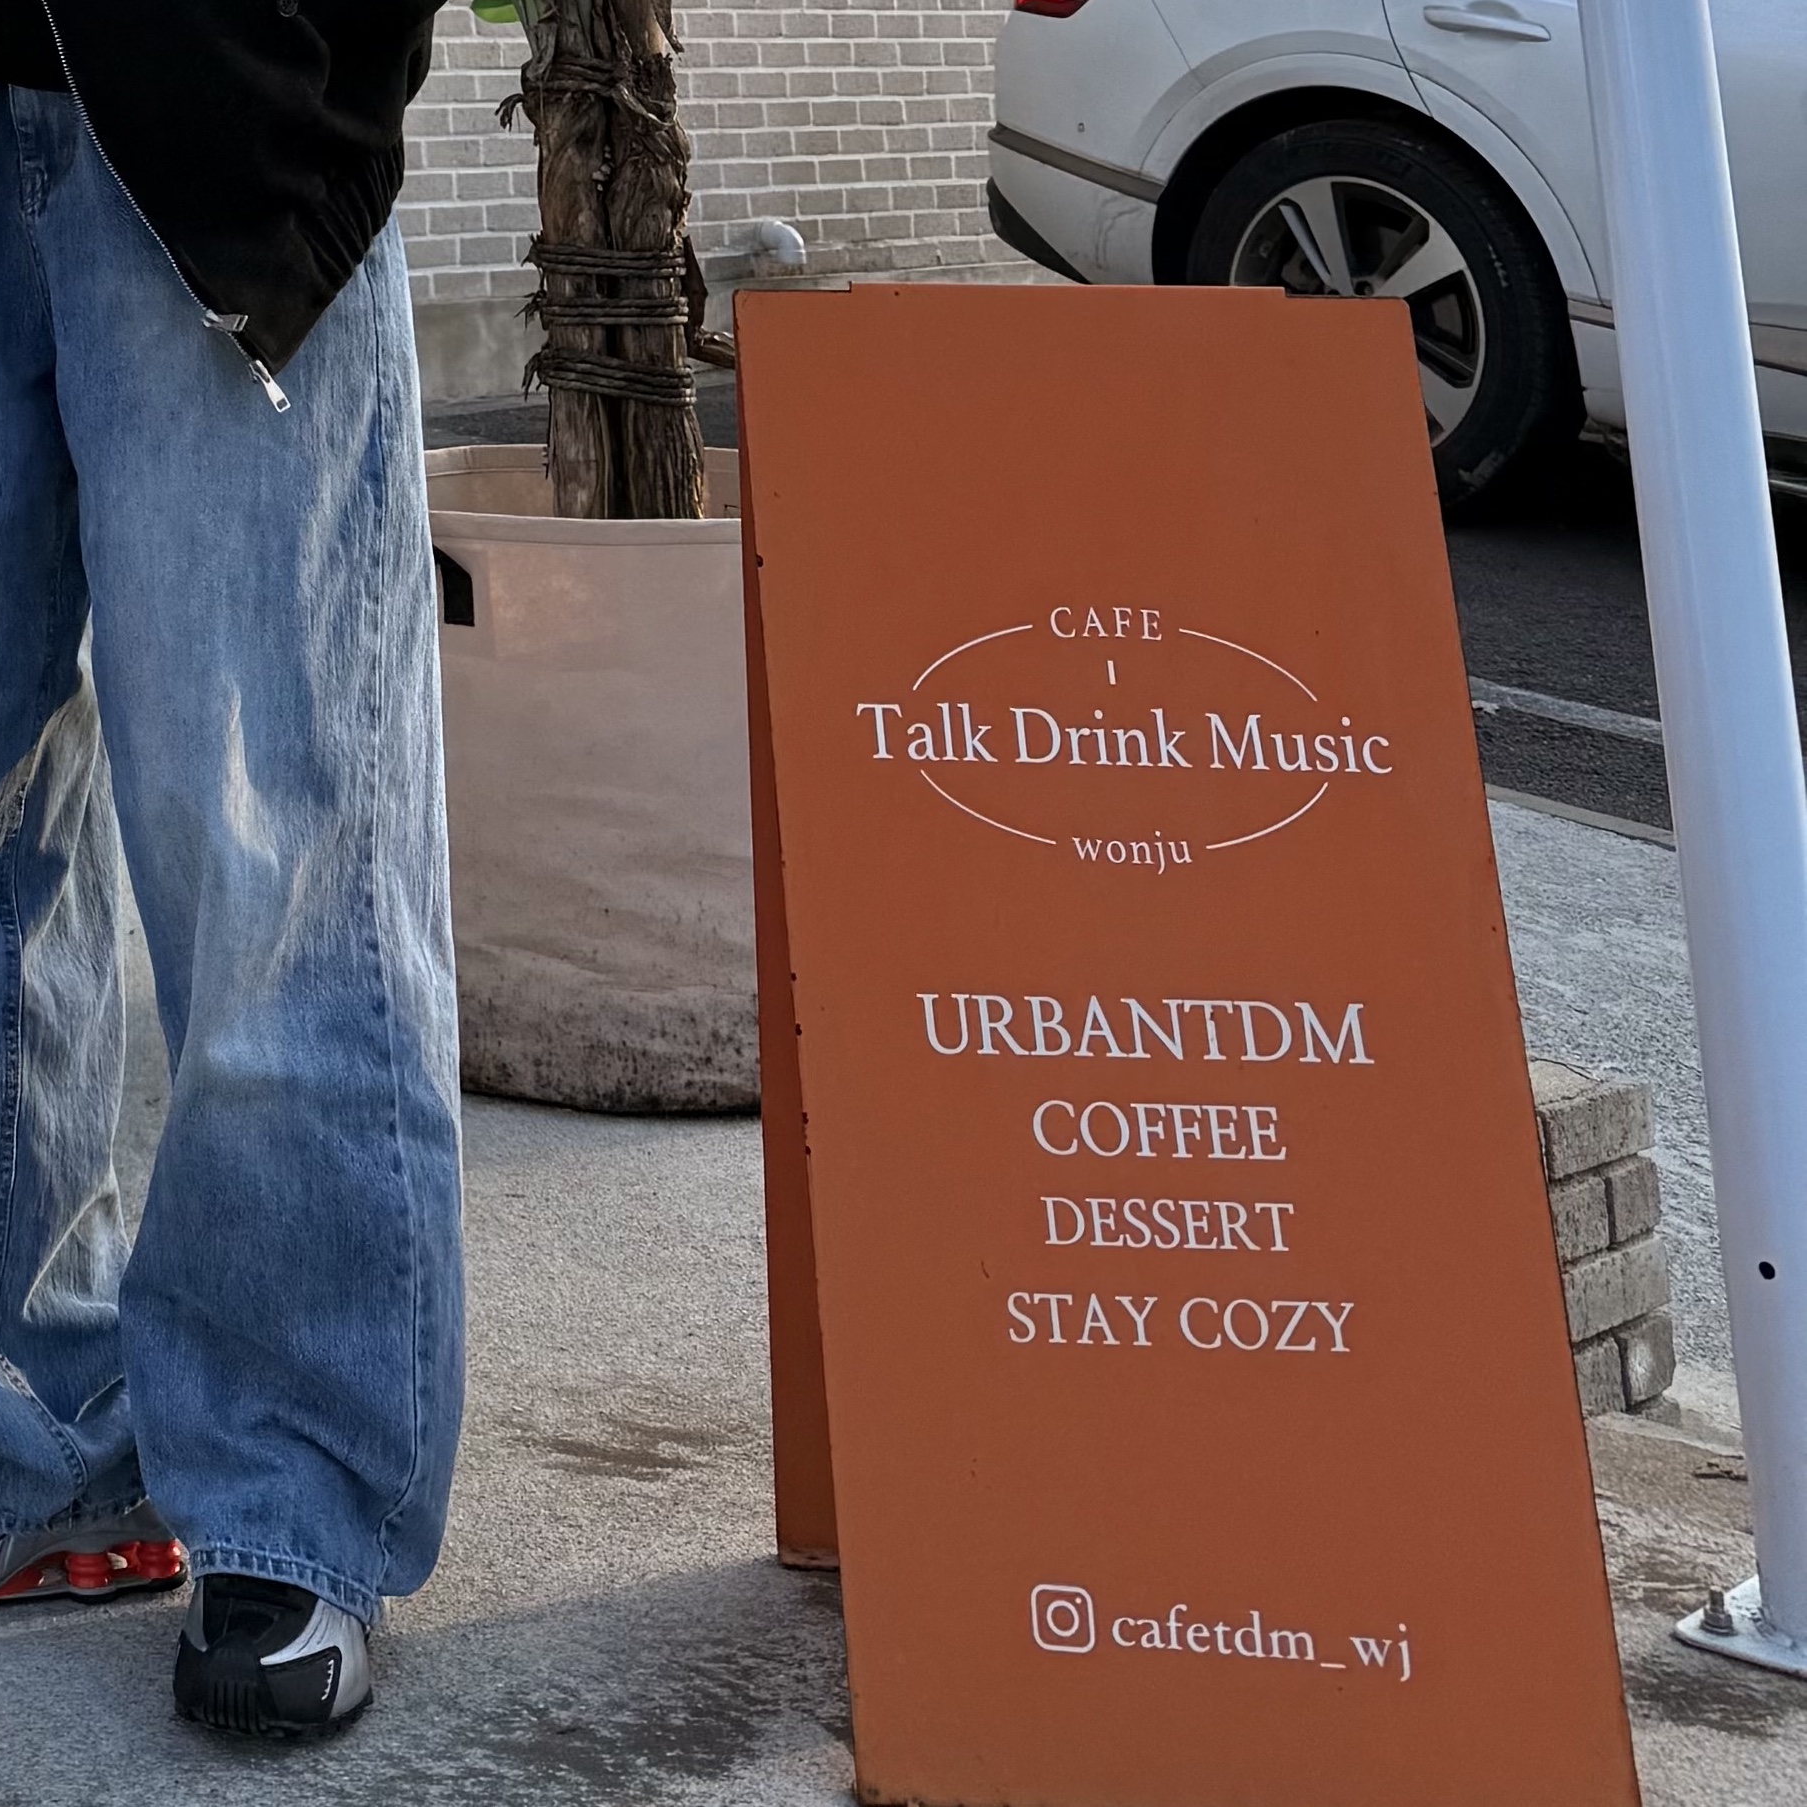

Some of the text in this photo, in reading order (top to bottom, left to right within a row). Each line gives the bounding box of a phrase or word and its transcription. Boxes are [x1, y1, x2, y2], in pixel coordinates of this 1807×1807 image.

[1050, 606, 1162, 641] CAFE
[856, 702, 1393, 774] Talk Drink Music
[1071, 830, 1193, 875] wonju
[916, 993, 1375, 1065] URBANTDM
[1032, 1099, 1287, 1161] COFFEE
[1040, 1196, 1295, 1252] DESSERT
[1007, 1291, 1355, 1353] STAY COZY
[1111, 1603, 1411, 1682] cafetdm_wj
